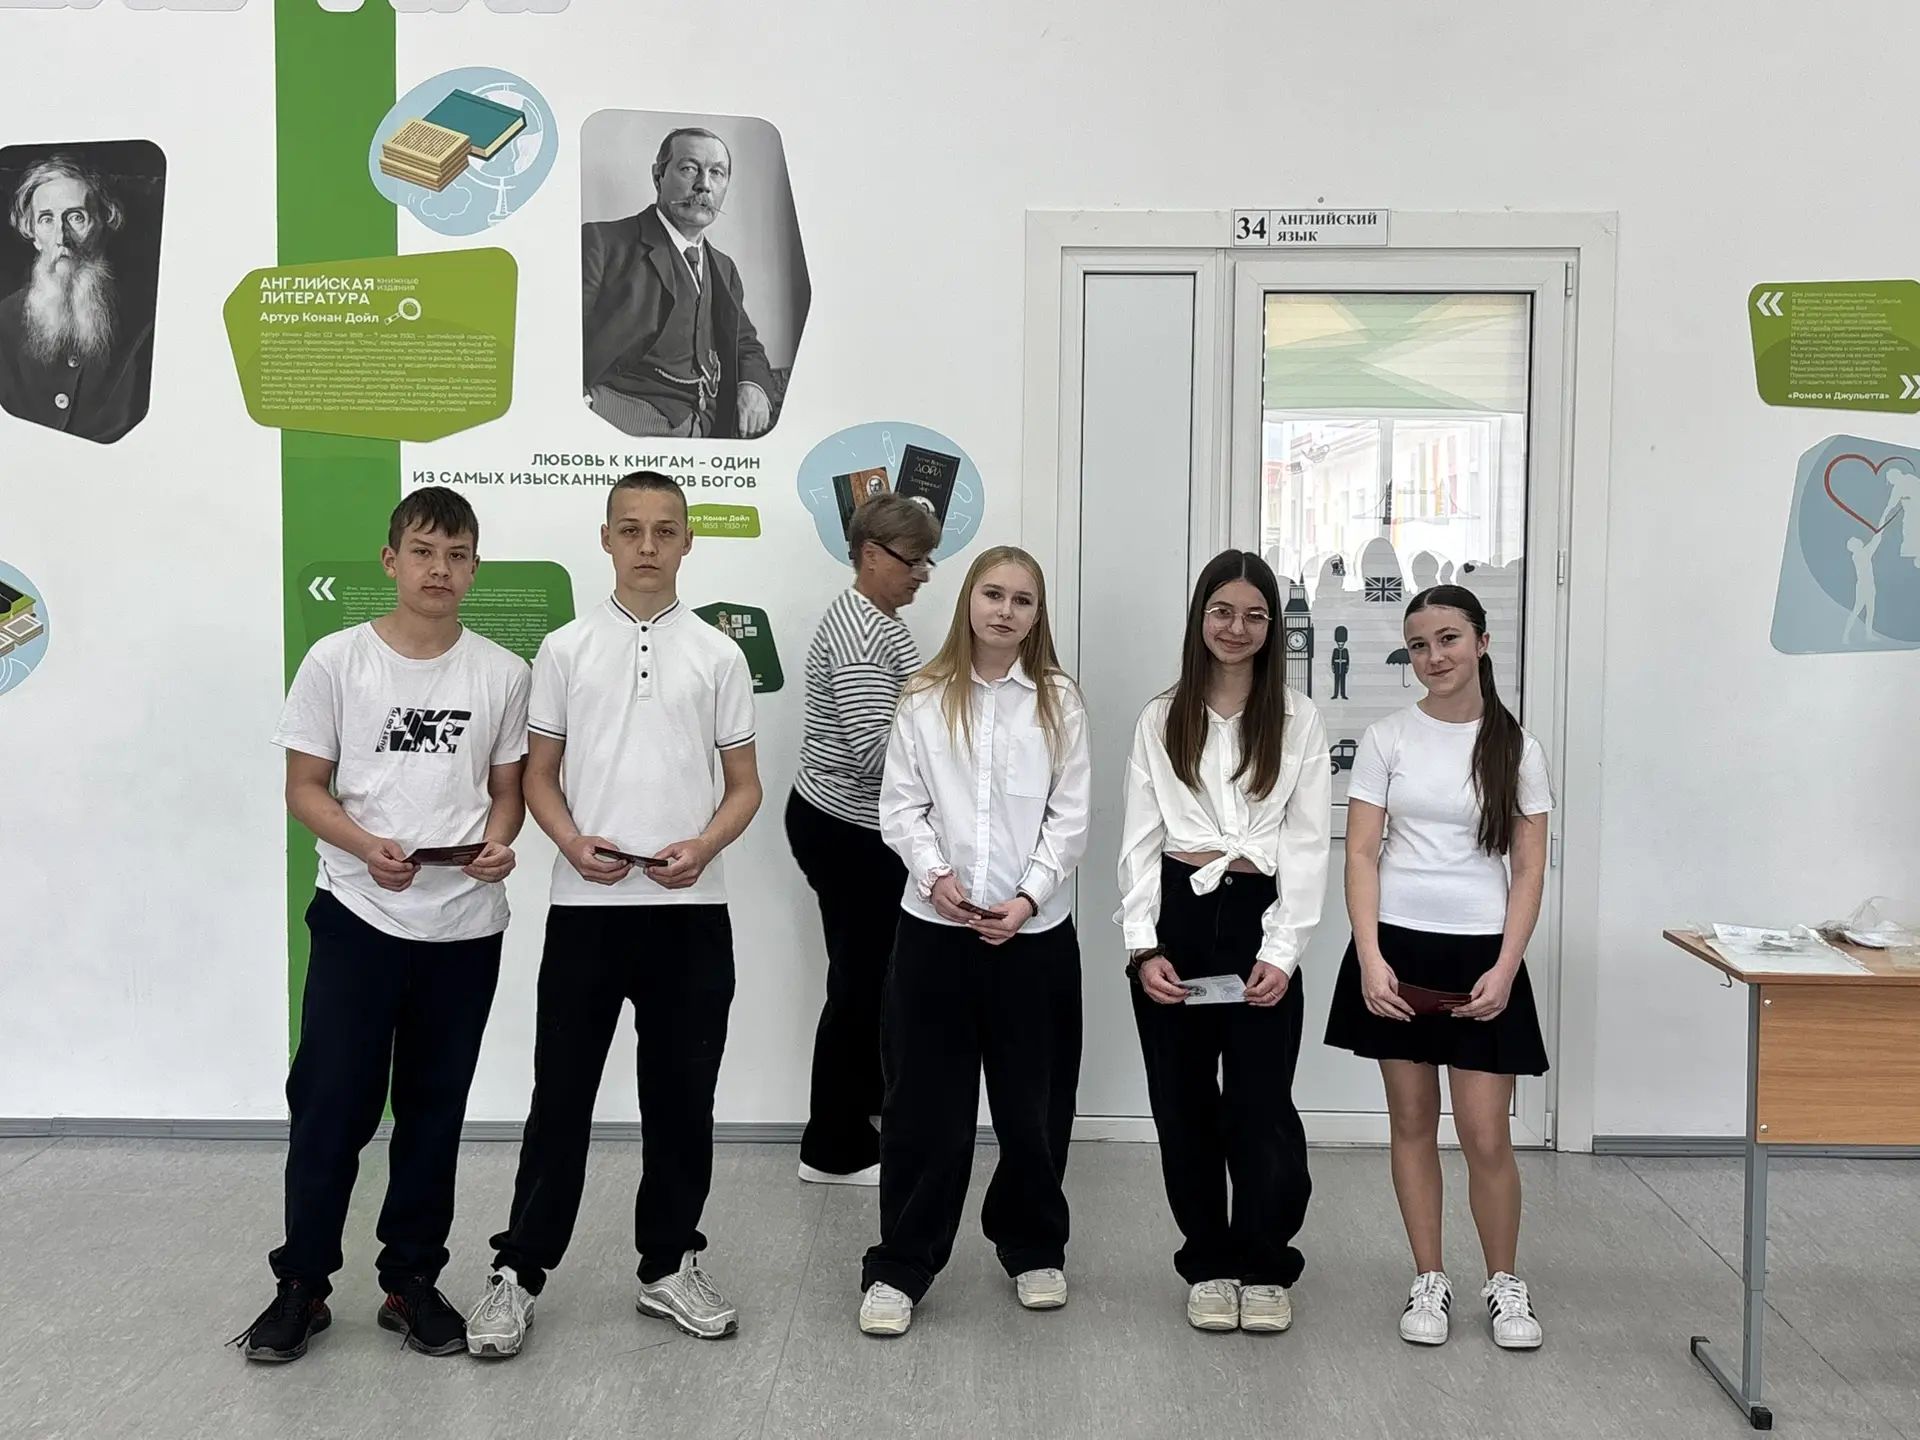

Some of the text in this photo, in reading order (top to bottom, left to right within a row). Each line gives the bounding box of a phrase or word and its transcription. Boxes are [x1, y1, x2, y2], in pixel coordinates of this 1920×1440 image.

[1277, 212, 1377, 225] АНГЛИЙСКИЙ
[1236, 217, 1267, 239] 34
[1277, 231, 1318, 242] ЯЗЫК
[260, 275, 374, 290] АНГЛИЙСКАЯ
[260, 292, 370, 304] ЛИТЕРАТУРА
[260, 312, 379, 324] Артур Конан Дойл
[1788, 391, 1823, 400] «Ромео
[1833, 391, 1890, 401] Джульетта»
[531, 453, 605, 467] ЛЮБОВЬ
[609, 454, 620, 467] К
[624, 455, 694, 468] КНИГАМ
[710, 456, 761, 470] ОДИН
[413, 471, 626, 487] ИЗ САМЫХ ИЗЫСКАННЫ
[702, 475, 757, 488] БОГОВ
[729, 515, 750, 523] Дойл
[379, 708, 398, 752] JUST DO IT
